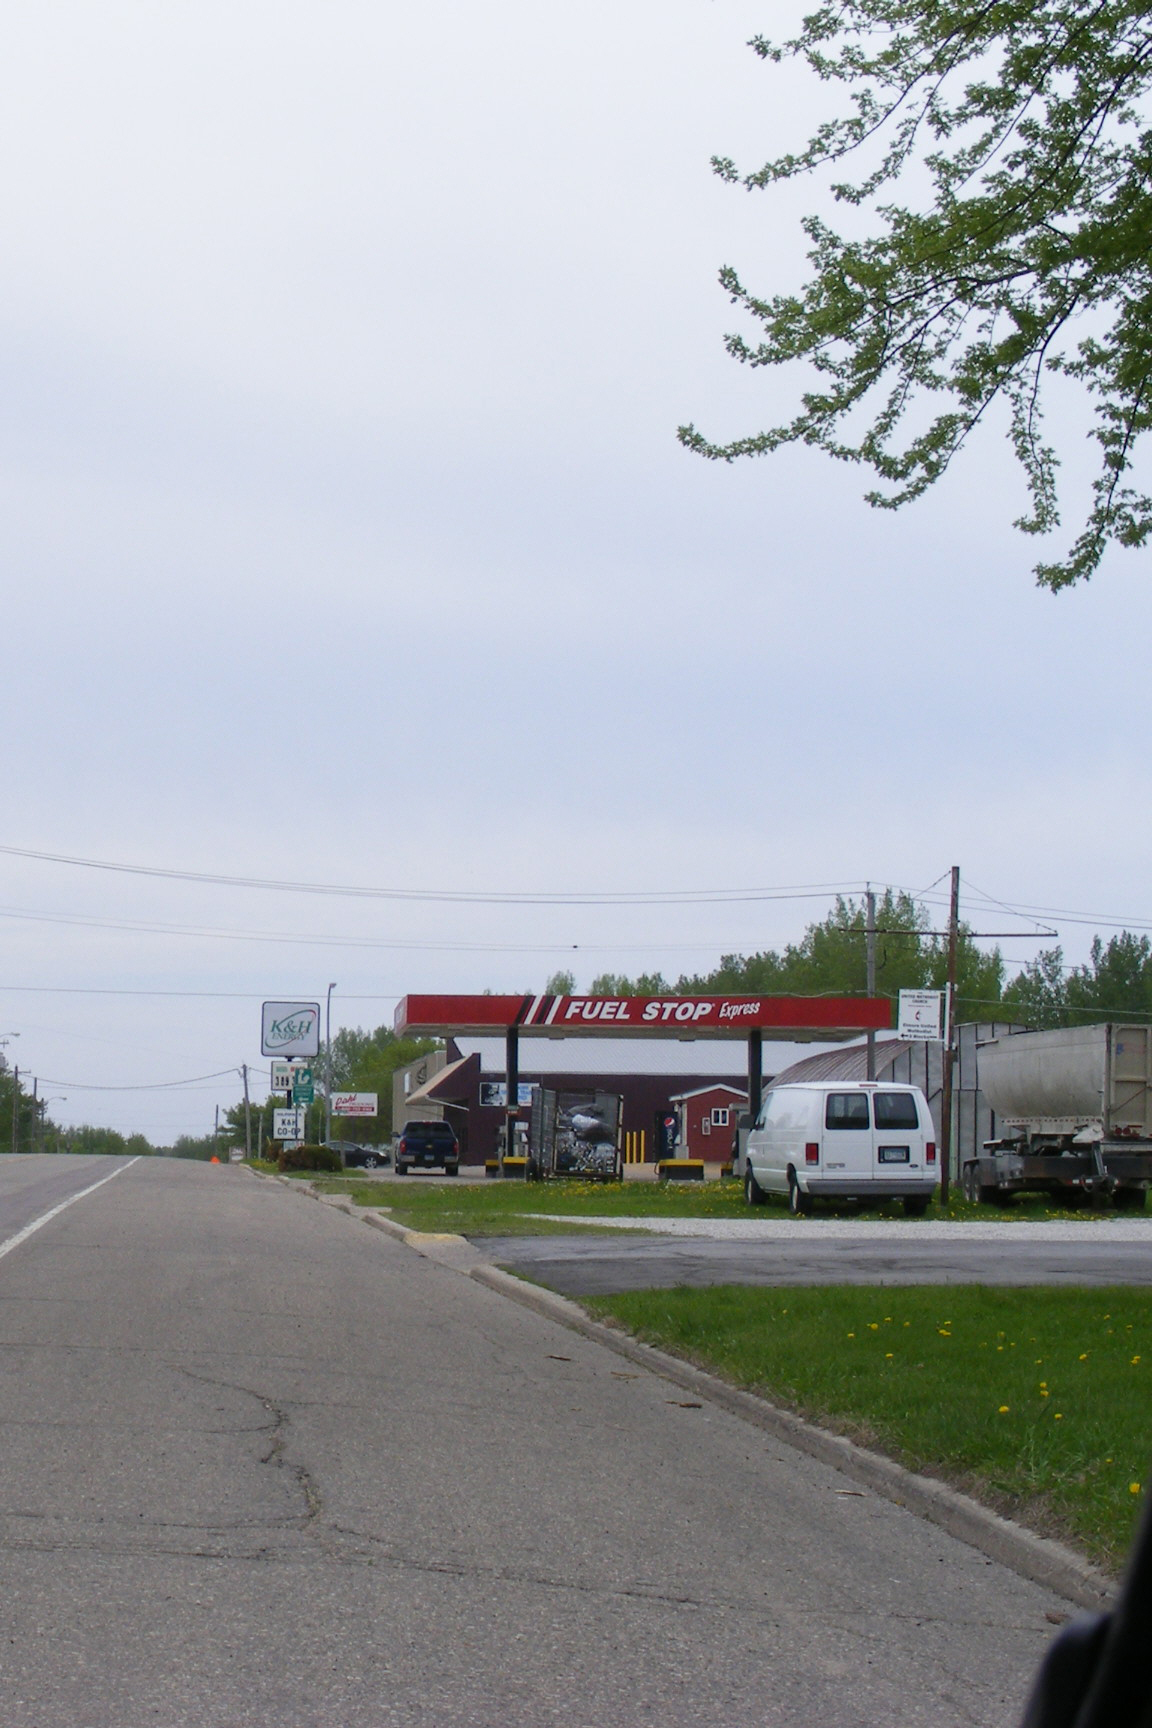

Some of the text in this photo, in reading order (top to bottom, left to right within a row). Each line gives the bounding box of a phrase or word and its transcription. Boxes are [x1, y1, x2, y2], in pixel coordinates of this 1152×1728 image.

[564, 1000, 762, 1021] FUEL STOP Express
[270, 1020, 312, 1033] K&H
